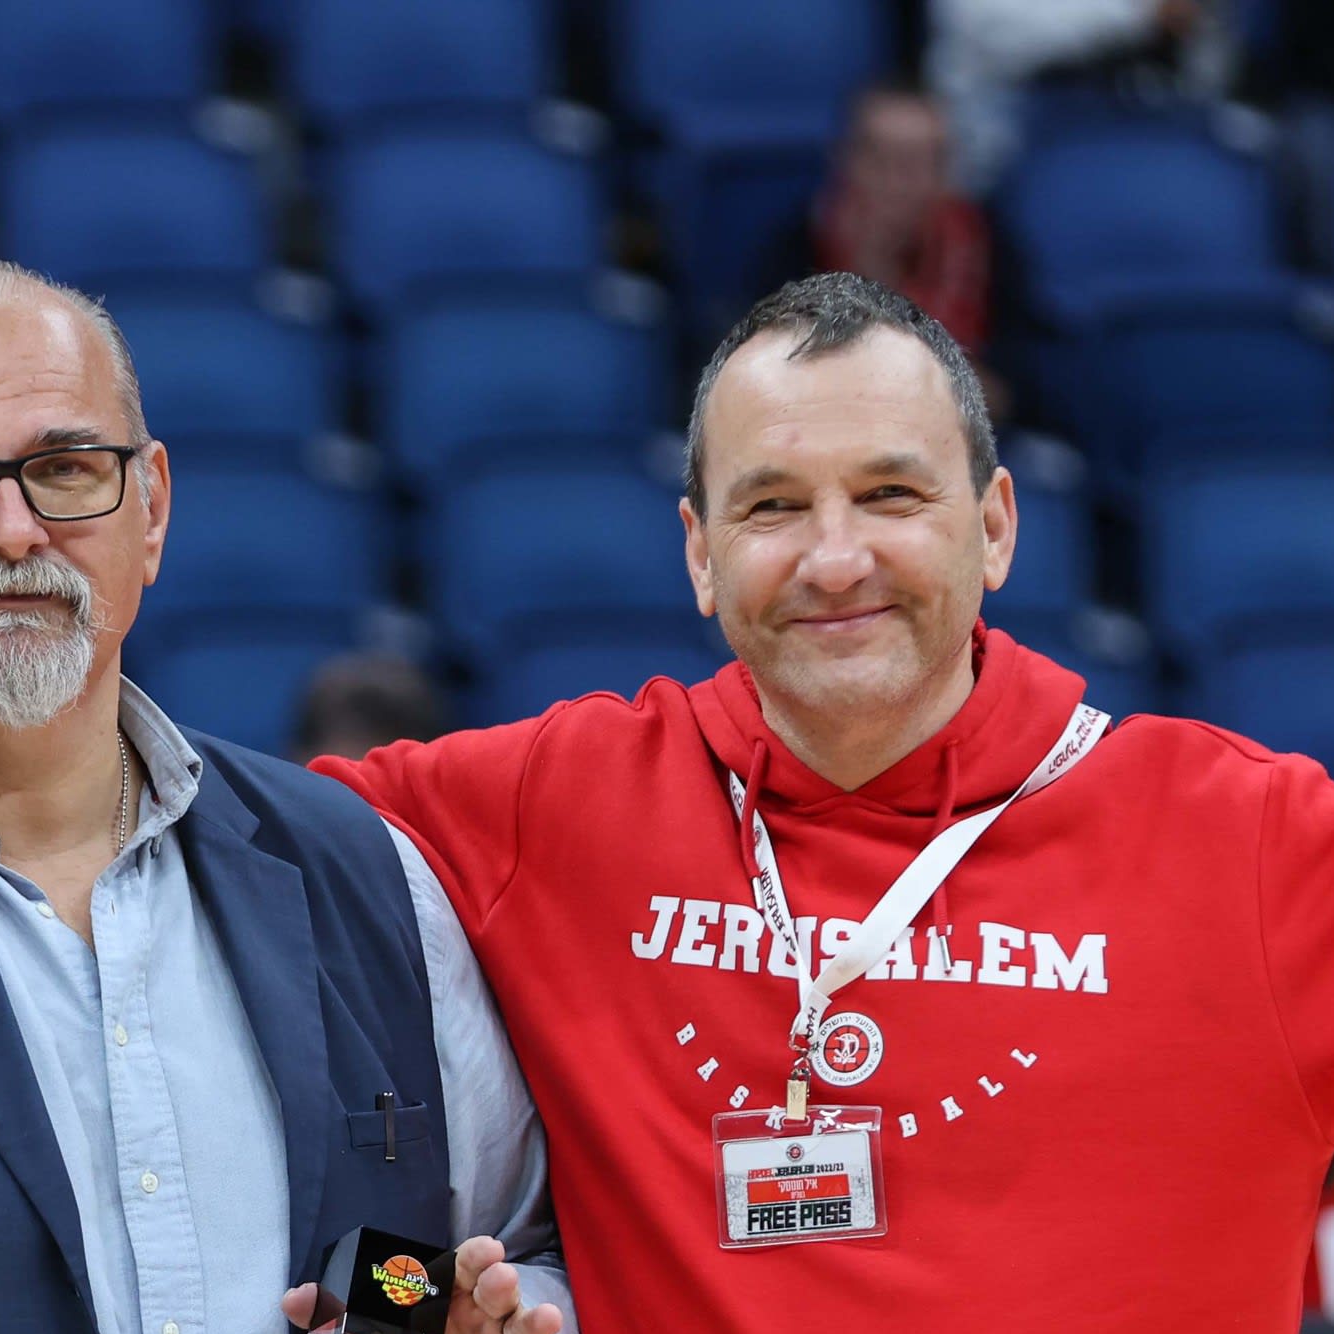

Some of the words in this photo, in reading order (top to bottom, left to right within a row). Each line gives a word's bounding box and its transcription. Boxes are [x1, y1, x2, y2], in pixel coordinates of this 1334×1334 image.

[630, 895, 1108, 994] JERUSALEM
[816, 1162, 844, 1173] 2022/23
[747, 1204, 797, 1231] FREE
[800, 1200, 852, 1227] PASS
